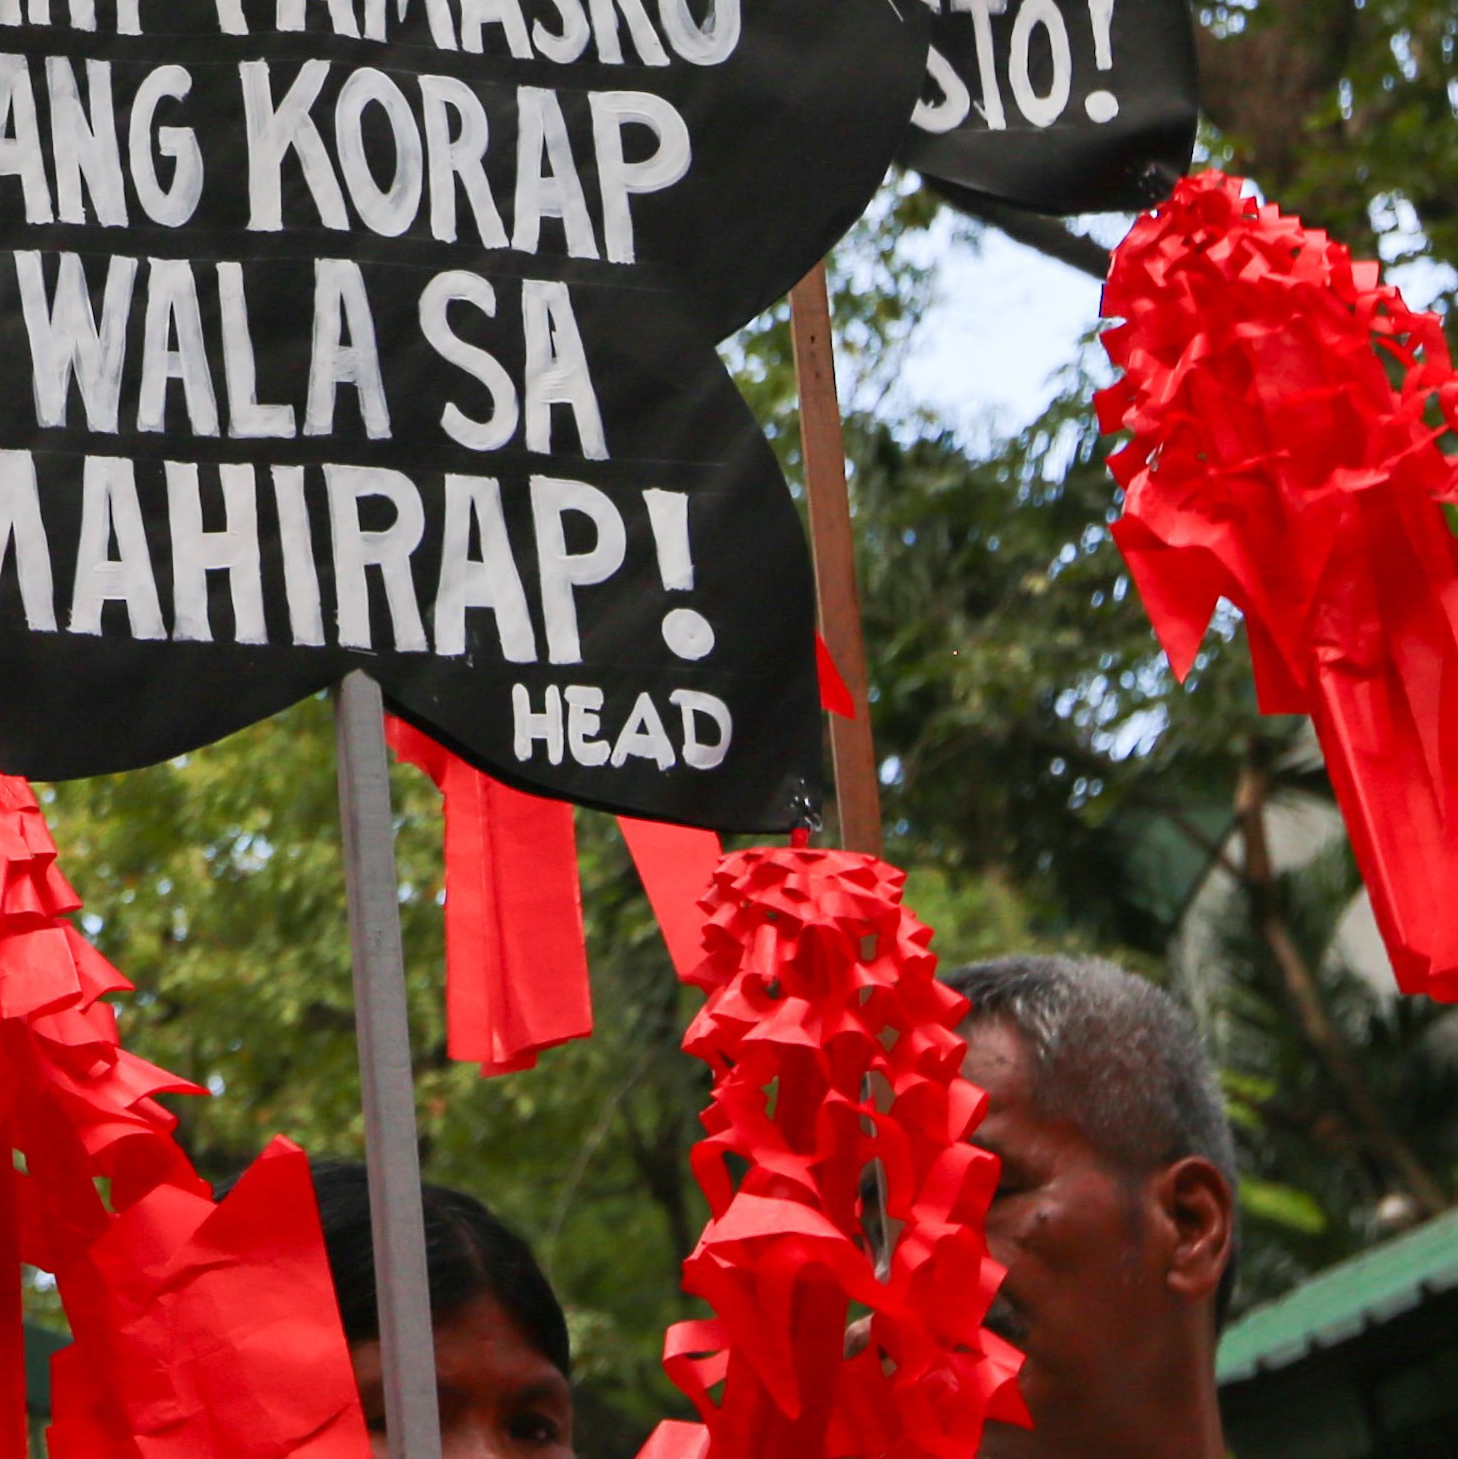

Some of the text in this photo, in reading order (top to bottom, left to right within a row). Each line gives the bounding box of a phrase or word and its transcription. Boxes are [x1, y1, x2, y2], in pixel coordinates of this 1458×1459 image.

[238, 58, 692, 265] KORAP
[13, 250, 609, 461] WALA SA
[511, 683, 733, 770] HEAD
